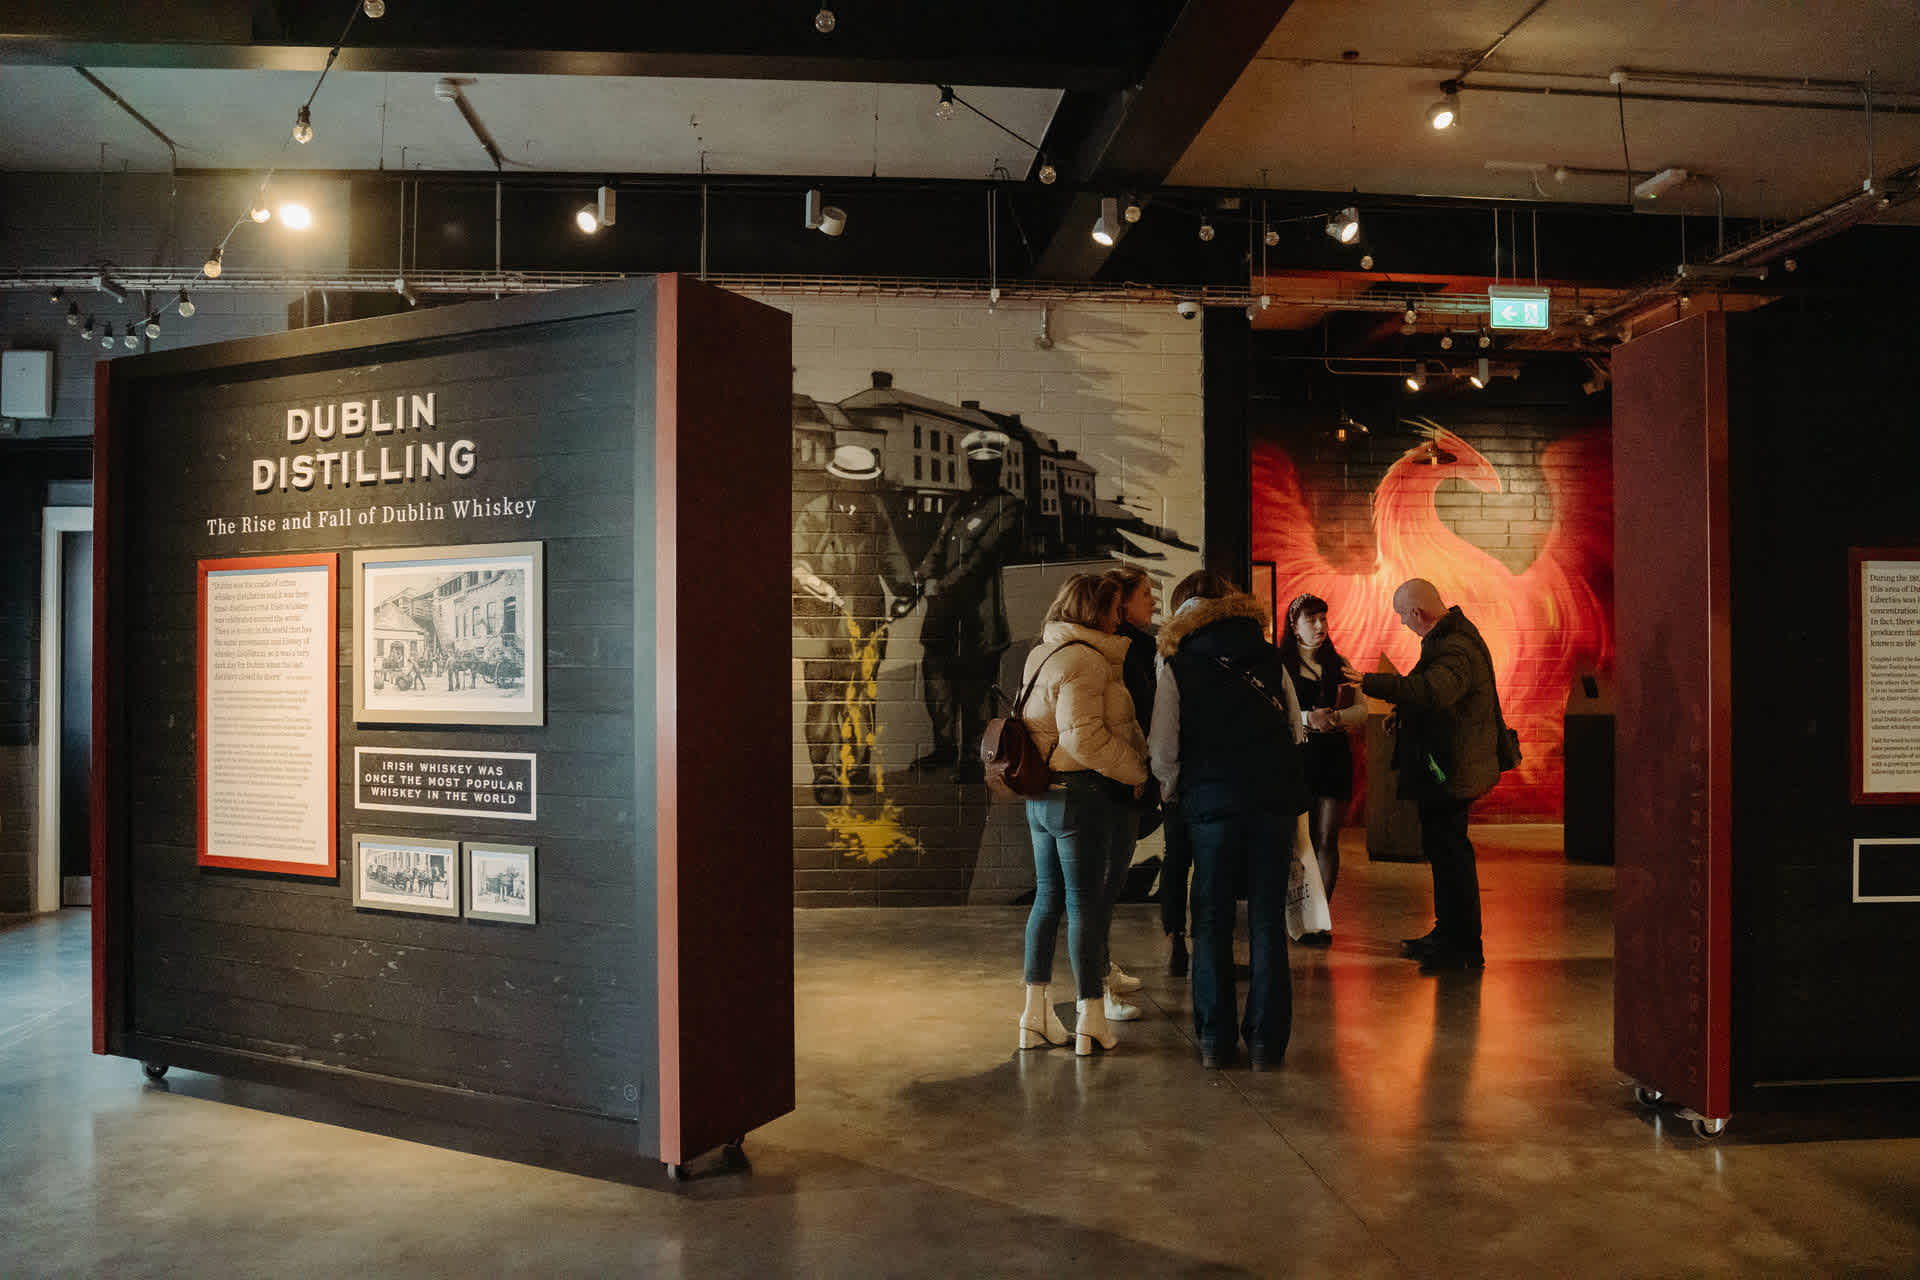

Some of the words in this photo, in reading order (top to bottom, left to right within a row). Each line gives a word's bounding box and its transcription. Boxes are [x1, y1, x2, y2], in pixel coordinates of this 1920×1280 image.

[287, 392, 437, 442] DUBLIN
[252, 439, 477, 493] DISTILLING
[207, 517, 236, 536] The
[242, 513, 275, 534] Rise
[282, 511, 312, 530] and
[318, 509, 351, 528] Fall
[358, 506, 377, 525] of
[382, 502, 445, 524] Dublin
[452, 496, 537, 519] Whiskey
[364, 774, 395, 785] ONCE
[399, 775, 422, 786] THE
[428, 776, 460, 788] MOST
[466, 779, 524, 791] POPULAR
[382, 761, 414, 772] IRISH
[419, 762, 473, 775] WHISKEY
[478, 765, 504, 776] WAS
[370, 786, 422, 799] WHISKEY
[427, 790, 439, 800] IN
[445, 791, 468, 802] THE
[474, 793, 516, 805] WORLD
